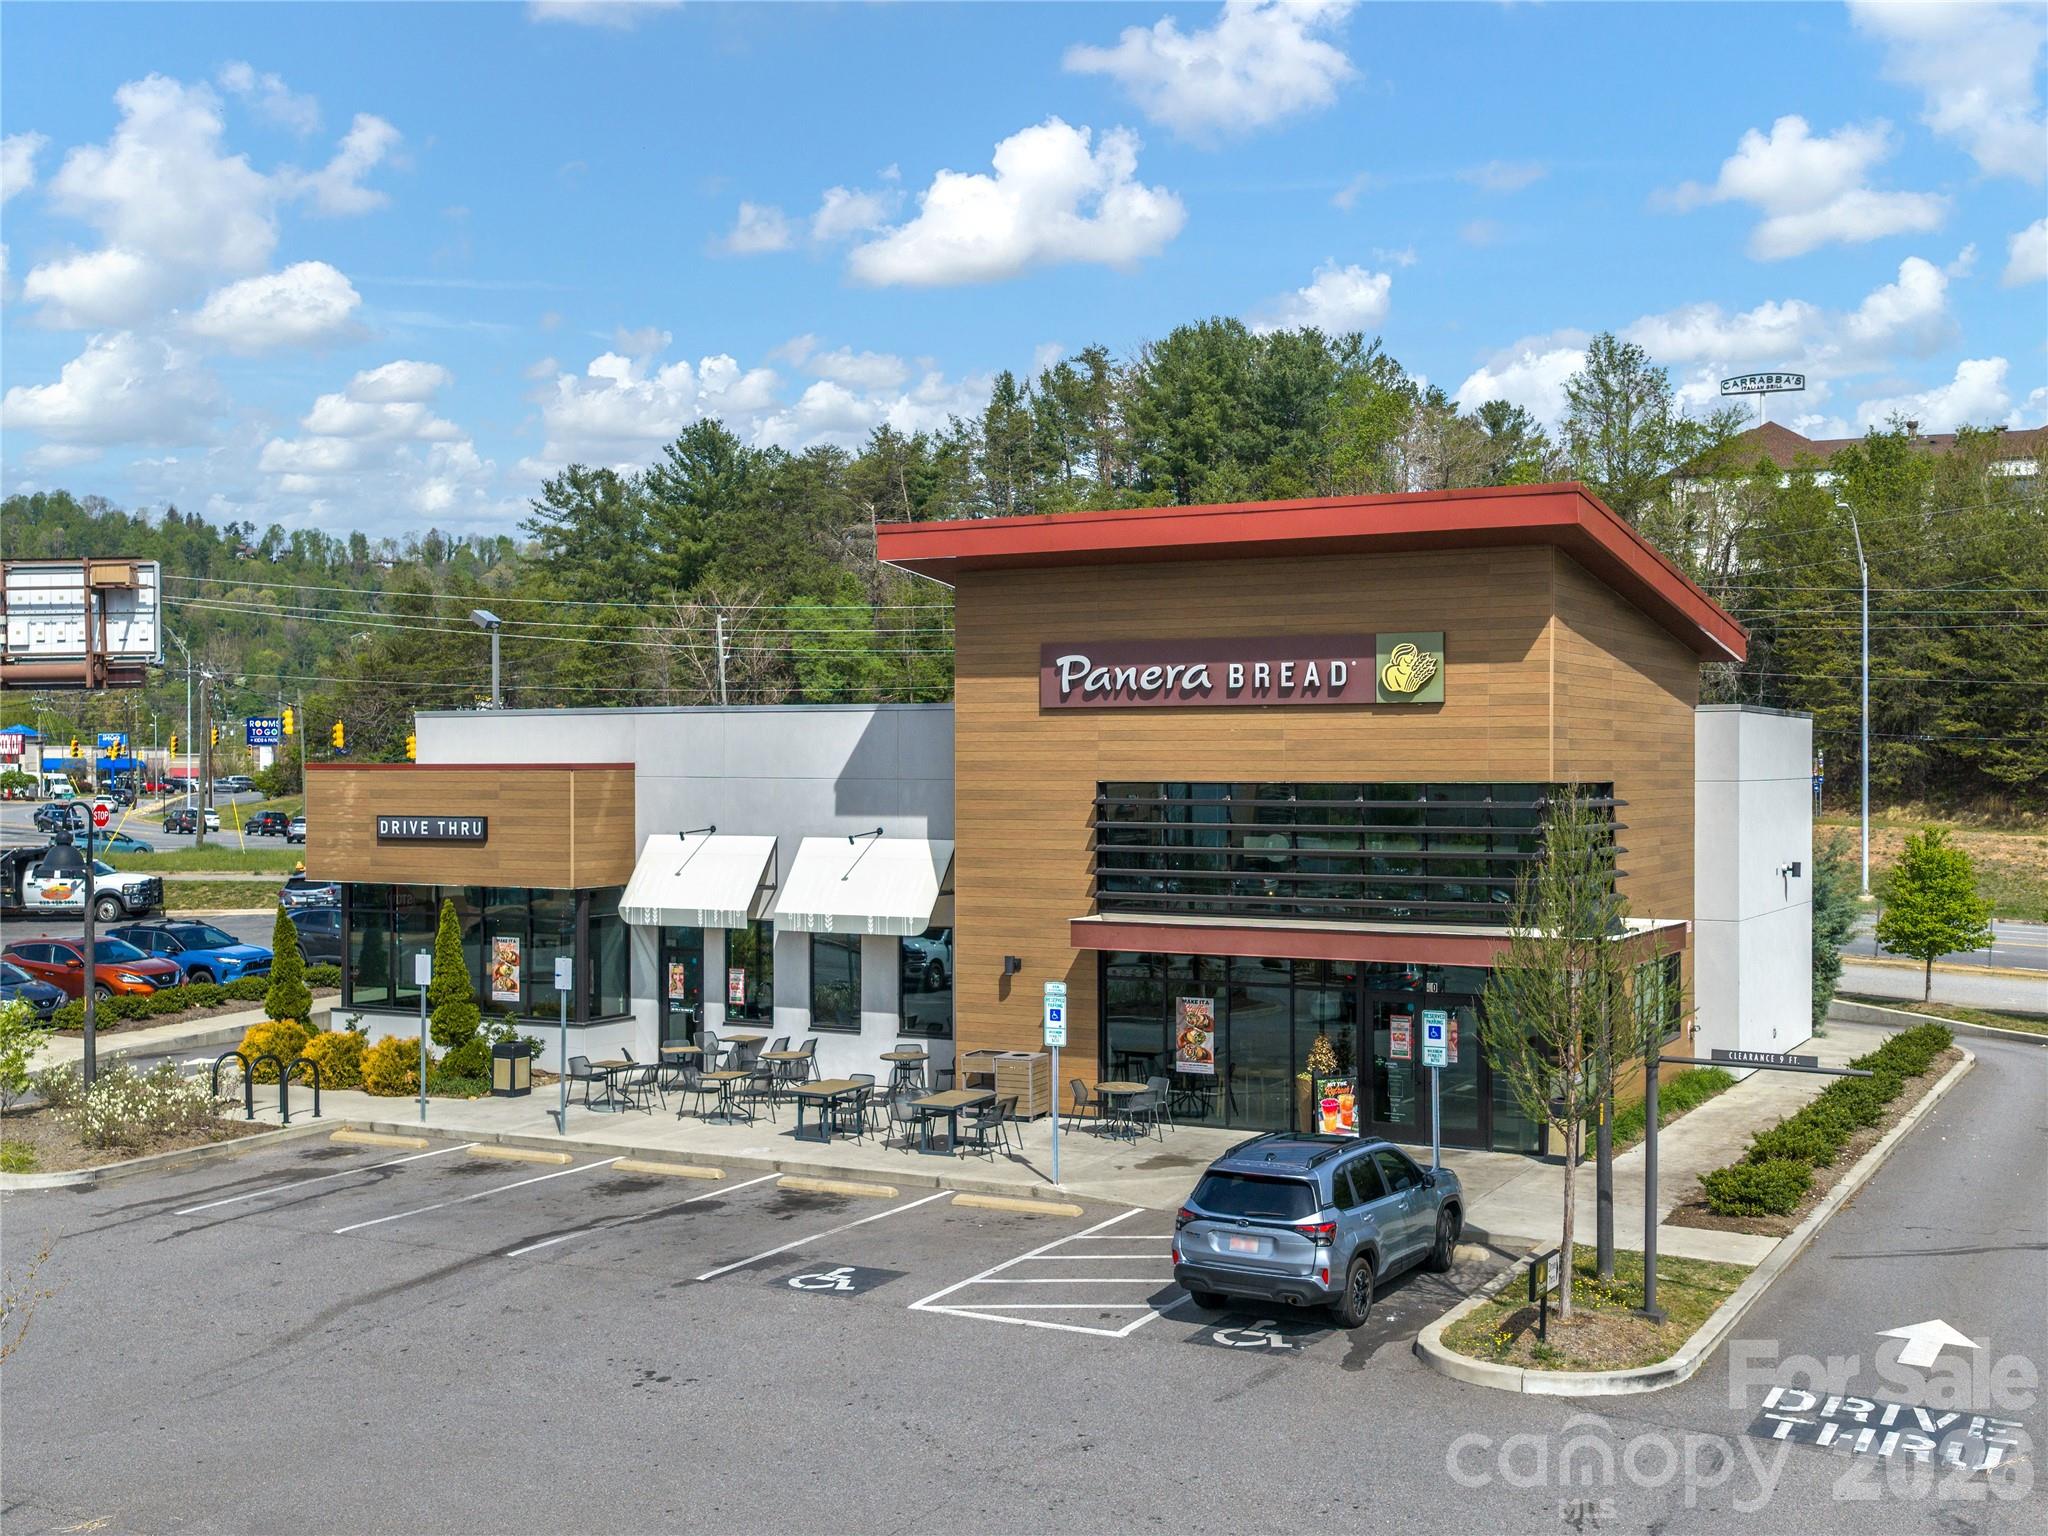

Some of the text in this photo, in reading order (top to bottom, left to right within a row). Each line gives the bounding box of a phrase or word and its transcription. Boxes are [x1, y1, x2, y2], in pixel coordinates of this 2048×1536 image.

[1722, 376, 1802, 390] CARRABBA'S
[1056, 654, 1348, 694] Panera BREAD
[249, 720, 280, 728] ROOMS
[252, 728, 278, 736] TO GO
[93, 810, 109, 820] STOP
[380, 820, 482, 836] DRIVE THRU
[1728, 1051, 1800, 1065] CLEARANCE 9 FT.
[1761, 1387, 2024, 1445] DRIVE
